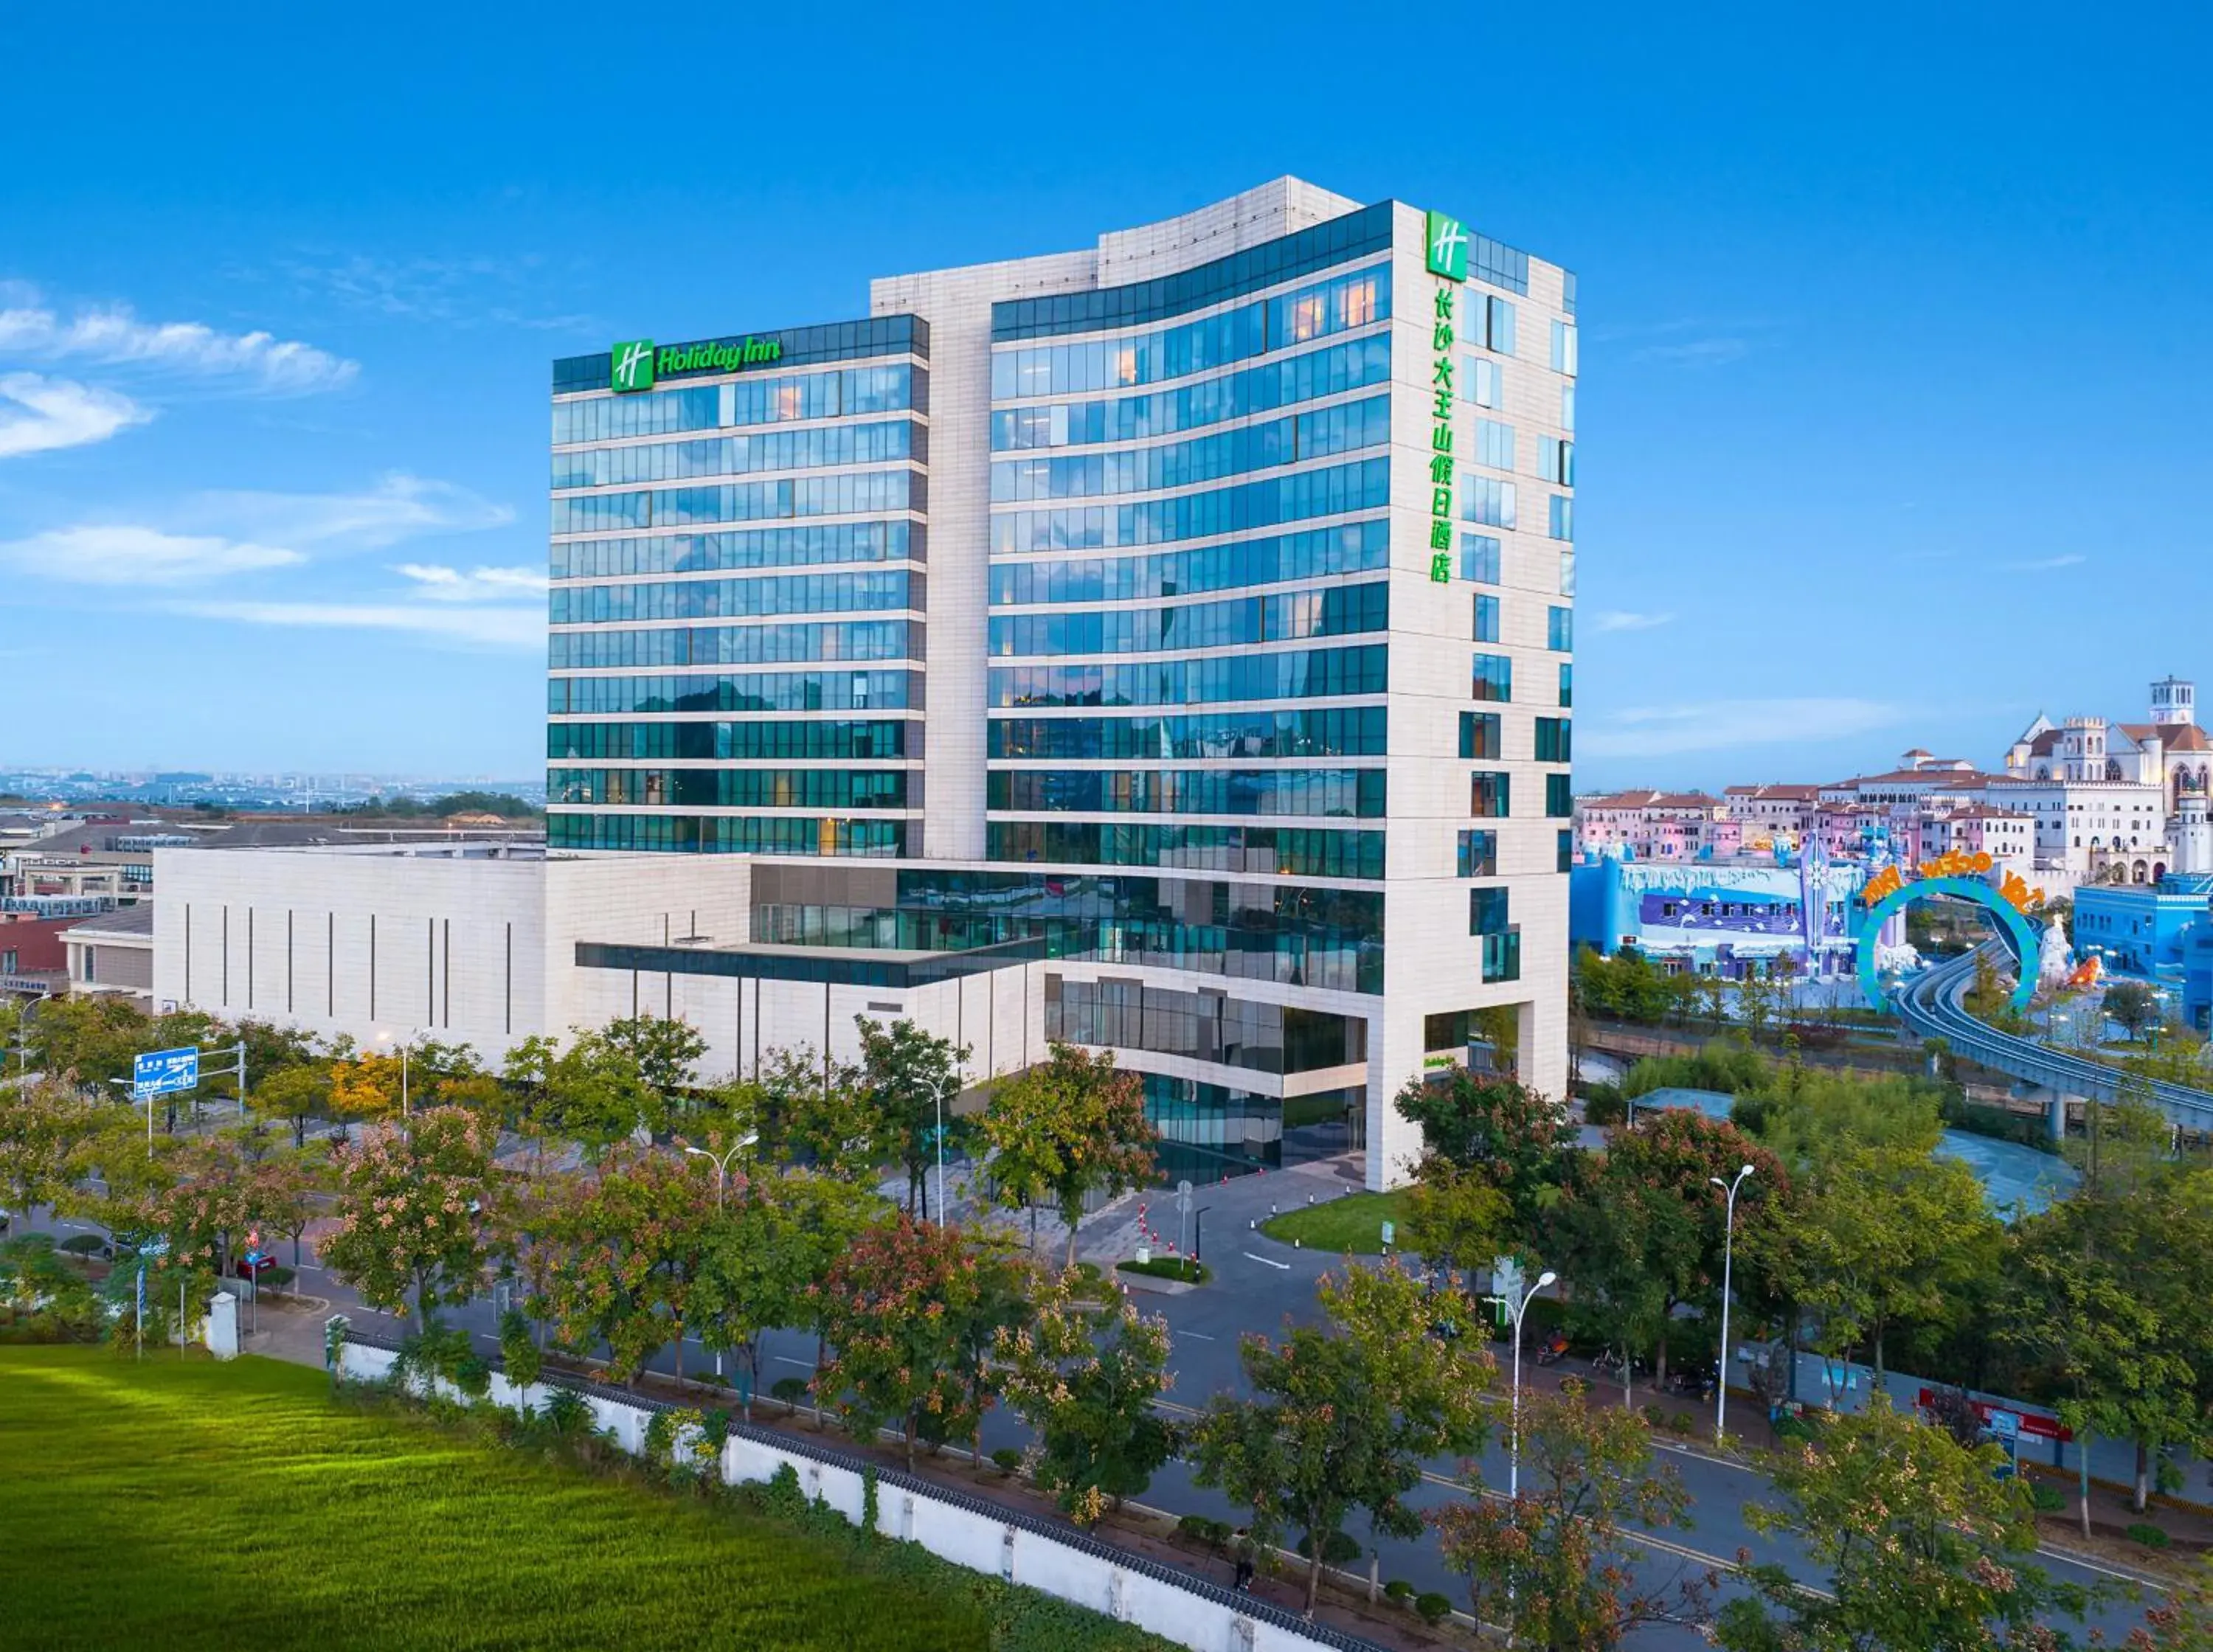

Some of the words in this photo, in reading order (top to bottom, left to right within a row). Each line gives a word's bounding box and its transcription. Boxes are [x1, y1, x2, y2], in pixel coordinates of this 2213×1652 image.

[658, 341, 741, 374] Holiday
[743, 336, 780, 363] Inn
[1430, 288, 1454, 583] 长沙大王山假日酒店
